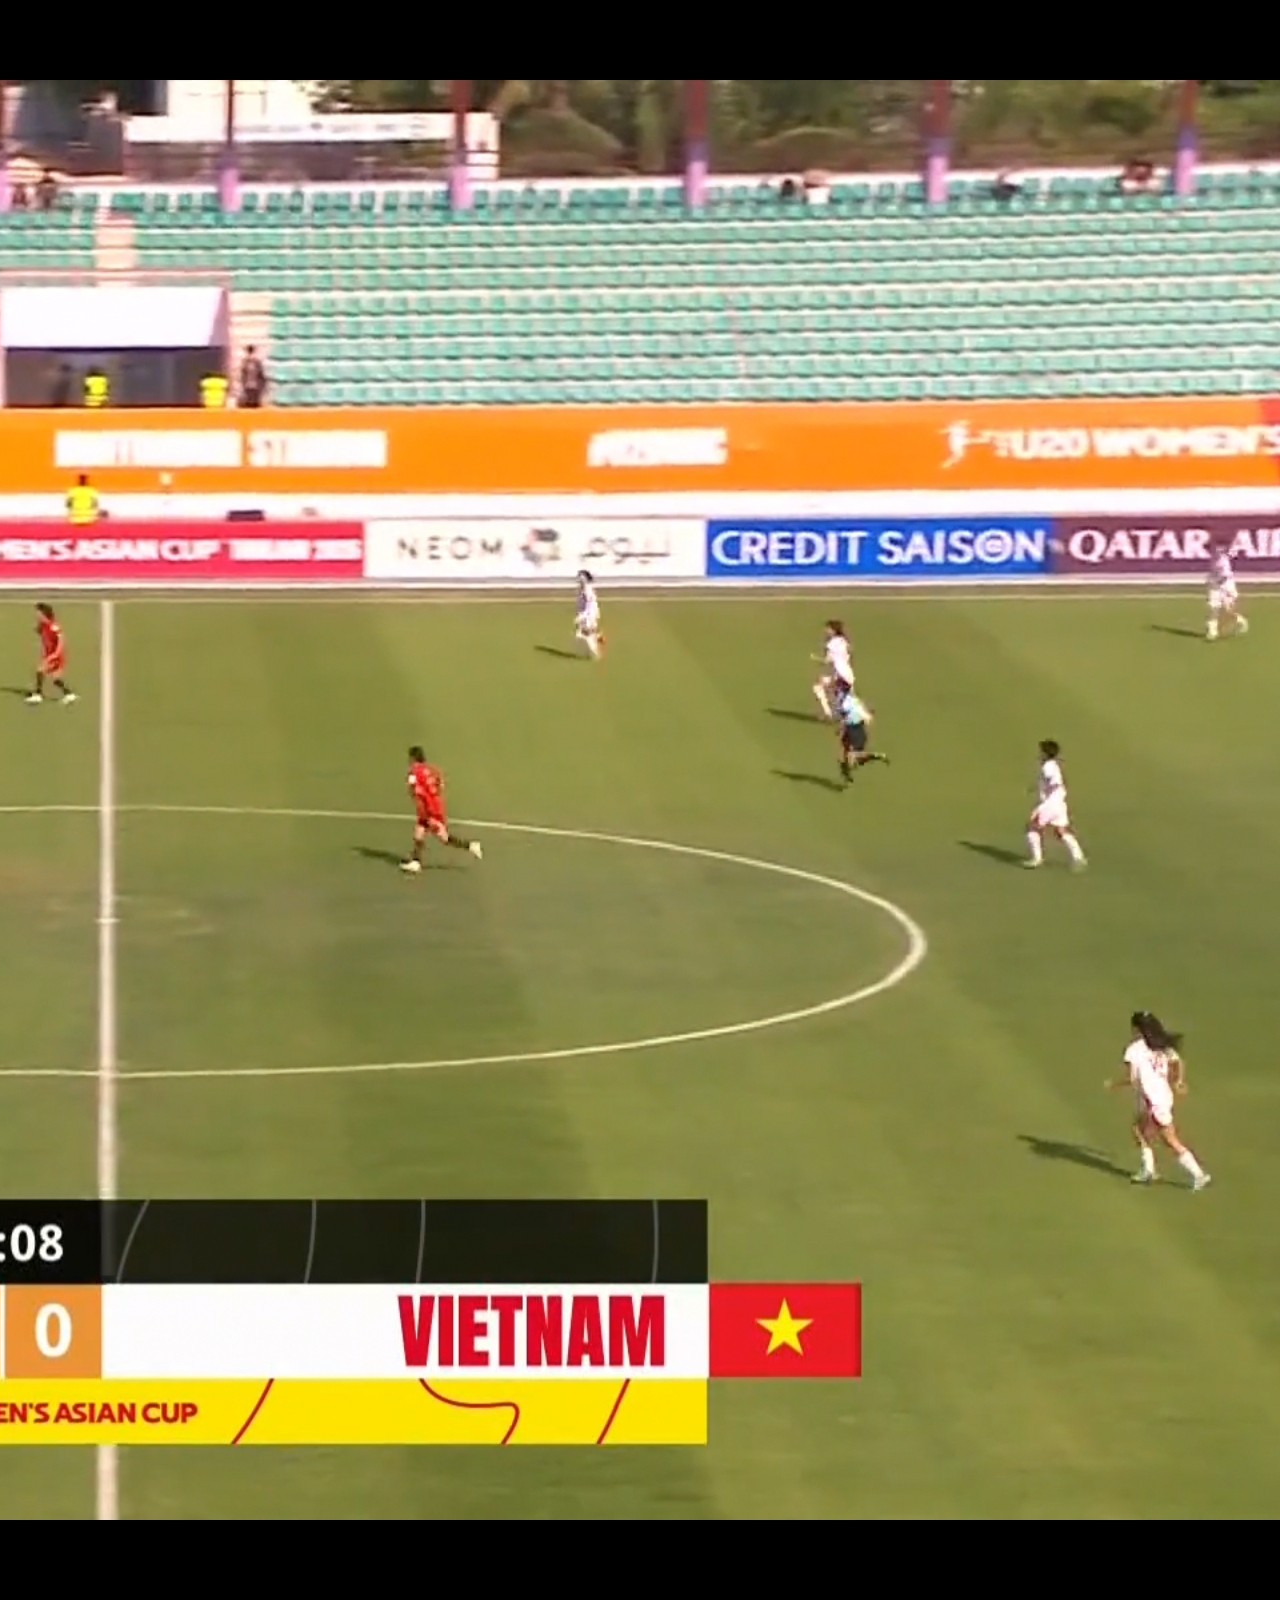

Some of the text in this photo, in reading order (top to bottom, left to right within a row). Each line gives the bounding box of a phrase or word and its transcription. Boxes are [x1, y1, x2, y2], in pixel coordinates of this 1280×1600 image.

[73, 539, 158, 561] ASIAN
[160, 539, 219, 561] CUP
[397, 536, 504, 561] NEOM
[711, 528, 1047, 566] CREDIT SAISON
[1068, 528, 1211, 561] QATAR
